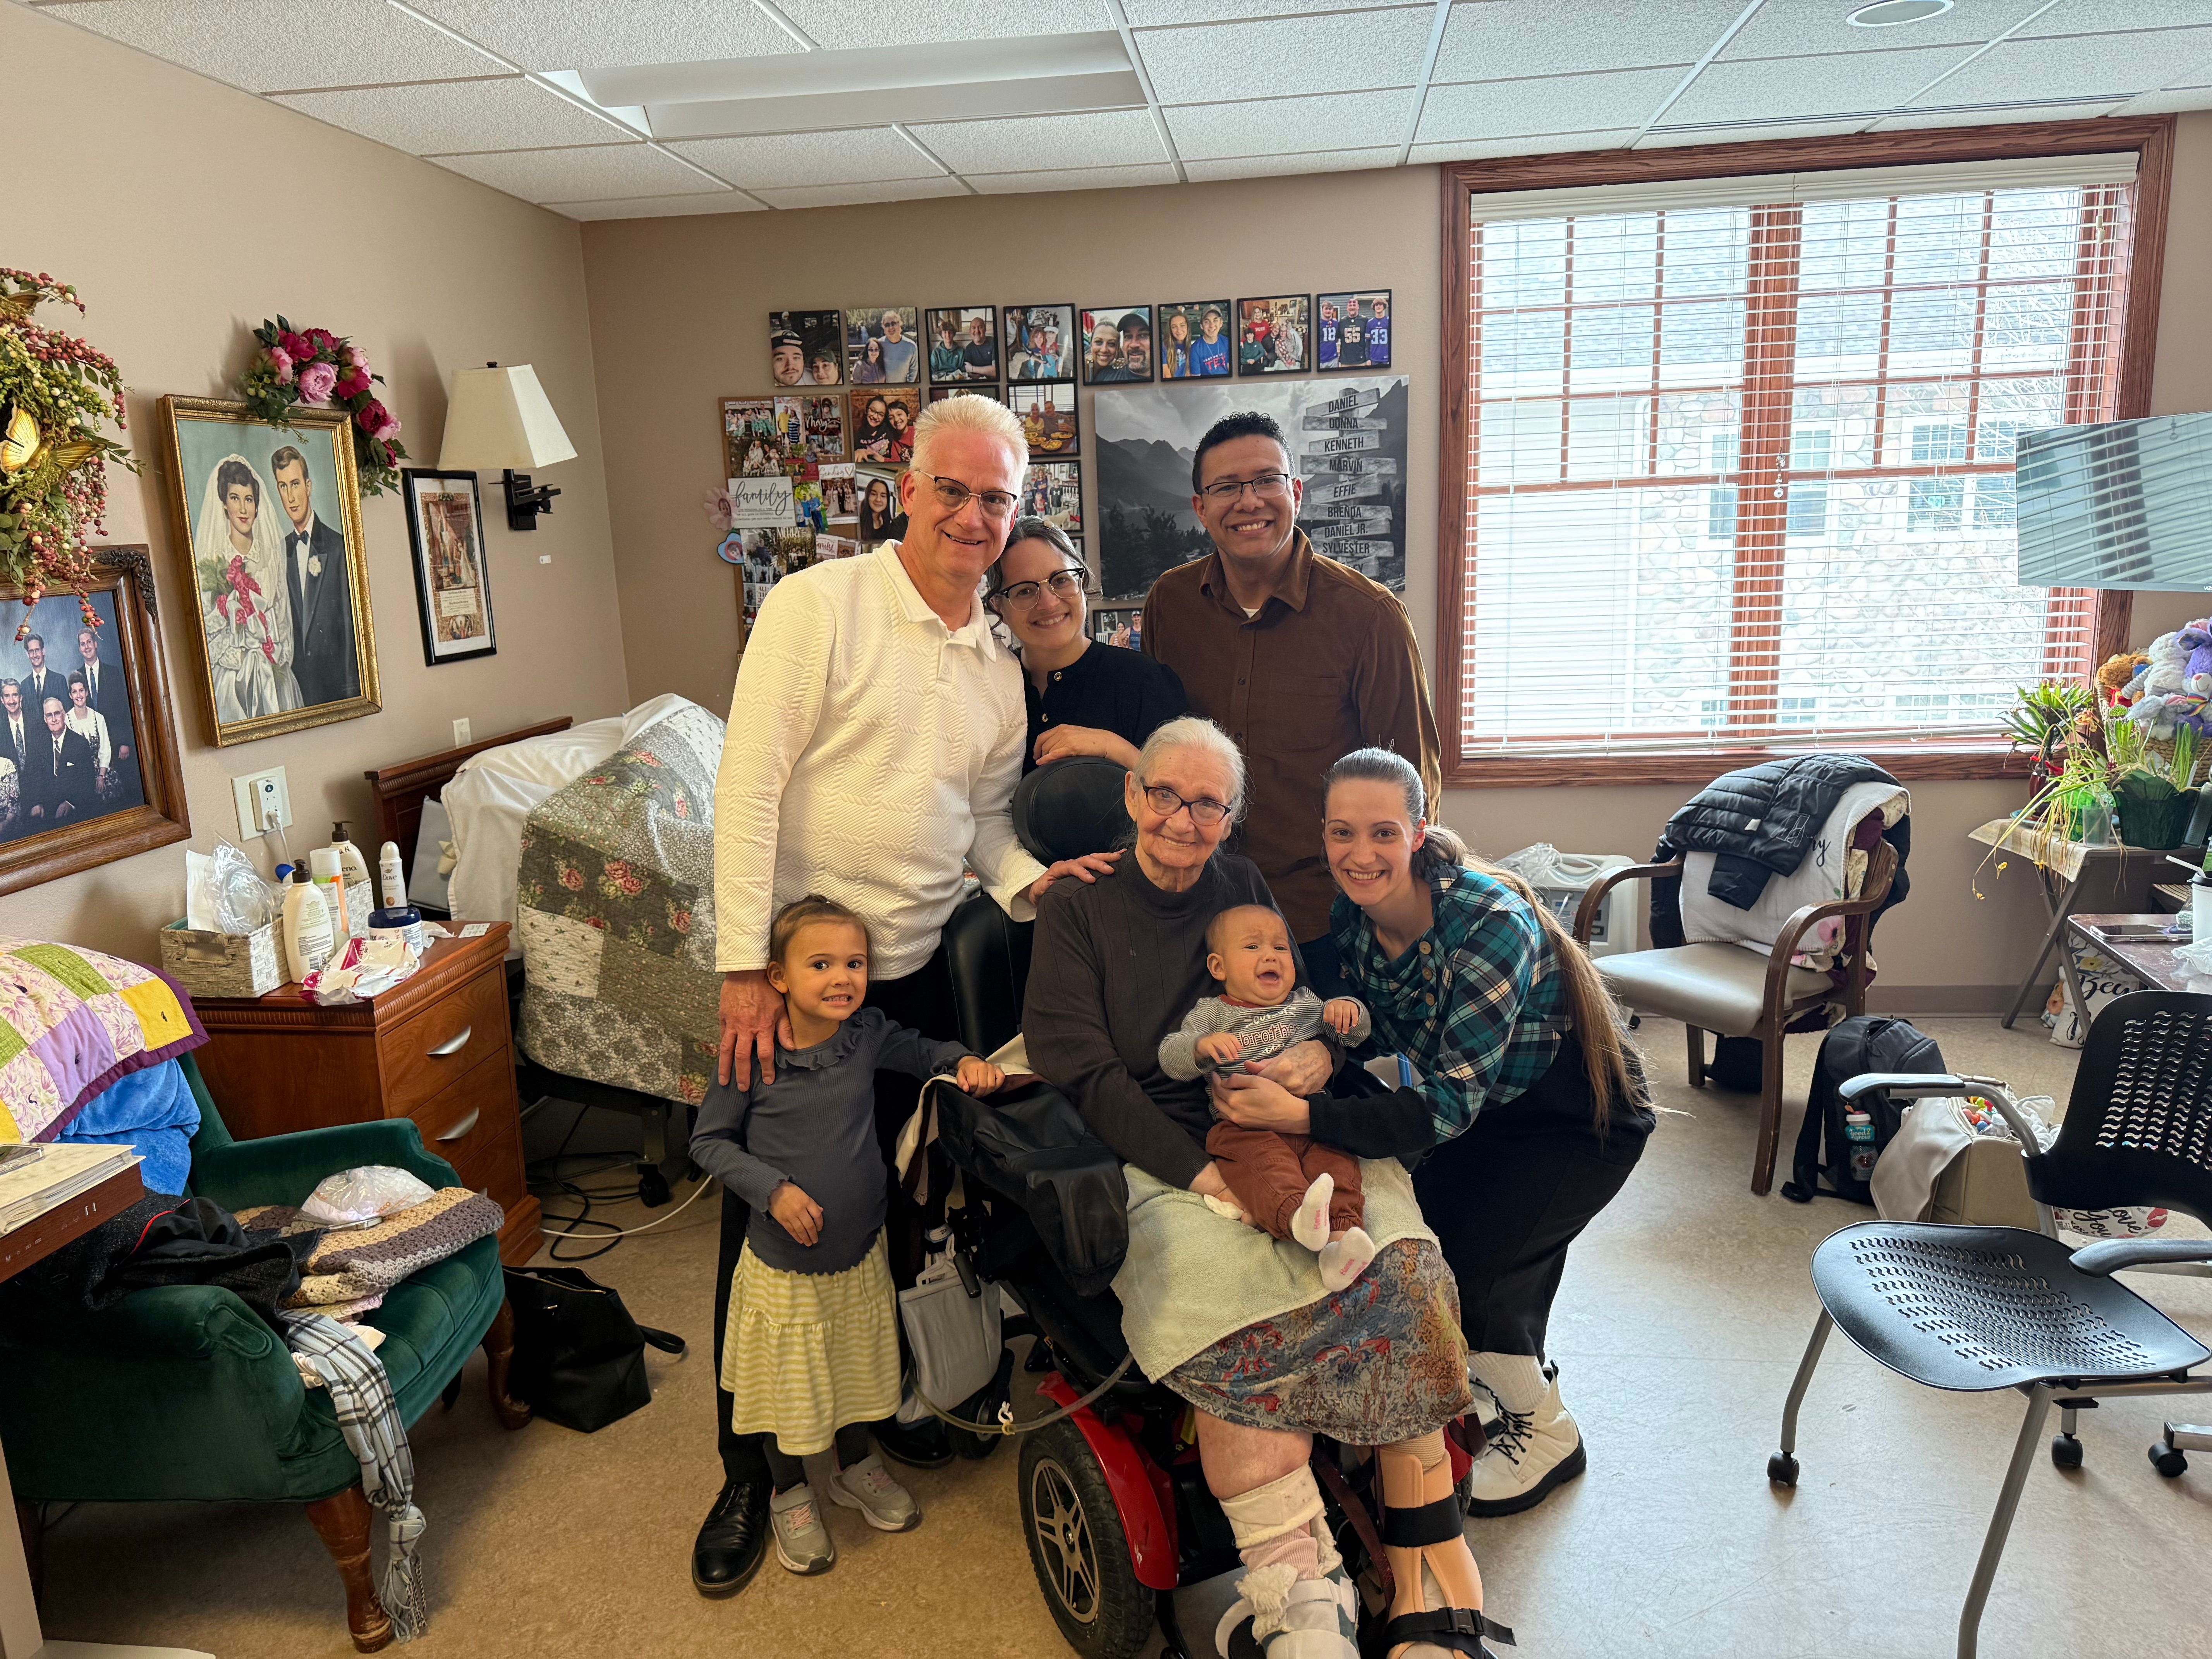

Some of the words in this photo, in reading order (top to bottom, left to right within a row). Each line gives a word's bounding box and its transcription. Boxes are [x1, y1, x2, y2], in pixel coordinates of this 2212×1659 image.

[1322, 327, 1336, 342] 18
[1344, 327, 1360, 343] 55
[1370, 328, 1388, 344] 33
[1328, 395, 1358, 412] DANIEL
[1329, 417, 1358, 429] DONNA
[1324, 436, 1364, 452] KENNETH
[1329, 459, 1362, 472] MARVIN
[1333, 483, 1356, 498] EFFIE
[732, 481, 792, 516] family
[1328, 506, 1362, 517] BRENDA
[1324, 525, 1354, 538] DANIEL
[1355, 523, 1368, 534] JR.
[816, 542, 834, 552] amily
[1322, 542, 1370, 554] SYLVESTER
[1240, 1022, 1299, 1048] brother
